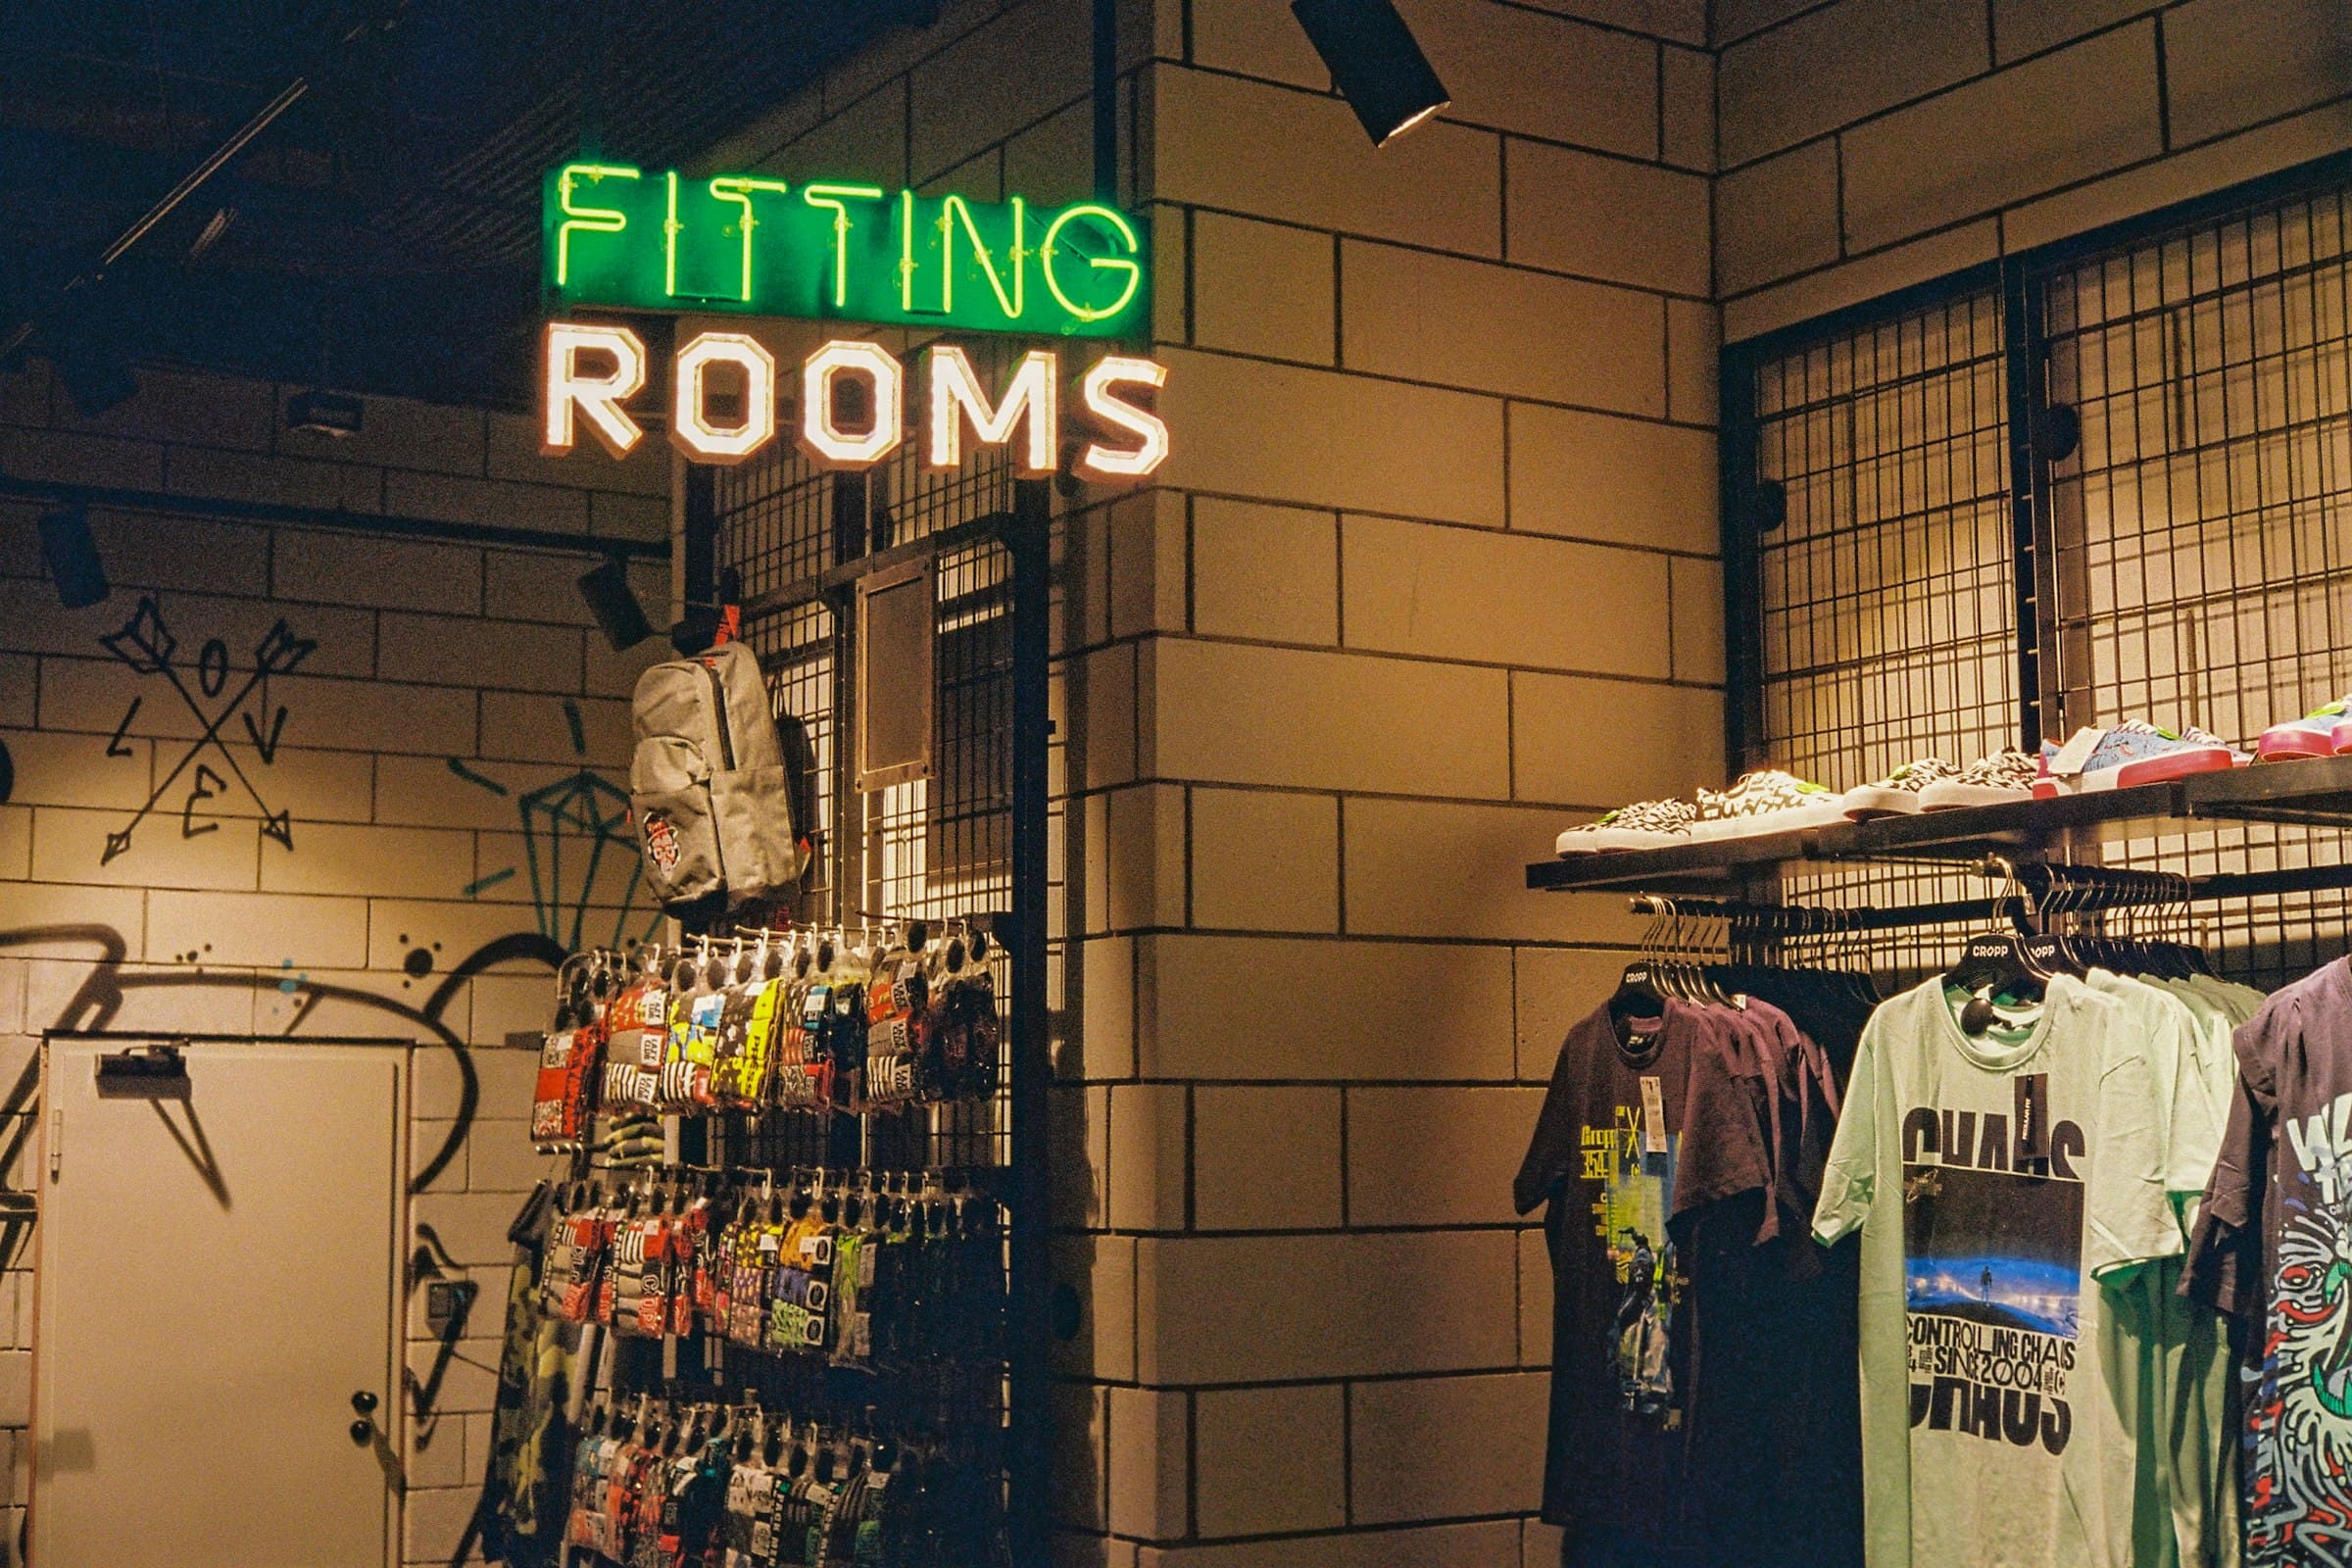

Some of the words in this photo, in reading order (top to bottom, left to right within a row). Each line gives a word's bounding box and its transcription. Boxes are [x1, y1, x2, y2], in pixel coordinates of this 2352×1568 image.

[556, 165, 1140, 319] FITTING
[545, 322, 1169, 477] ROOMS
[1972, 945, 2009, 957] CROPP
[1626, 971, 1647, 984] CROPP
[1981, 1354, 2041, 1393] 2004
